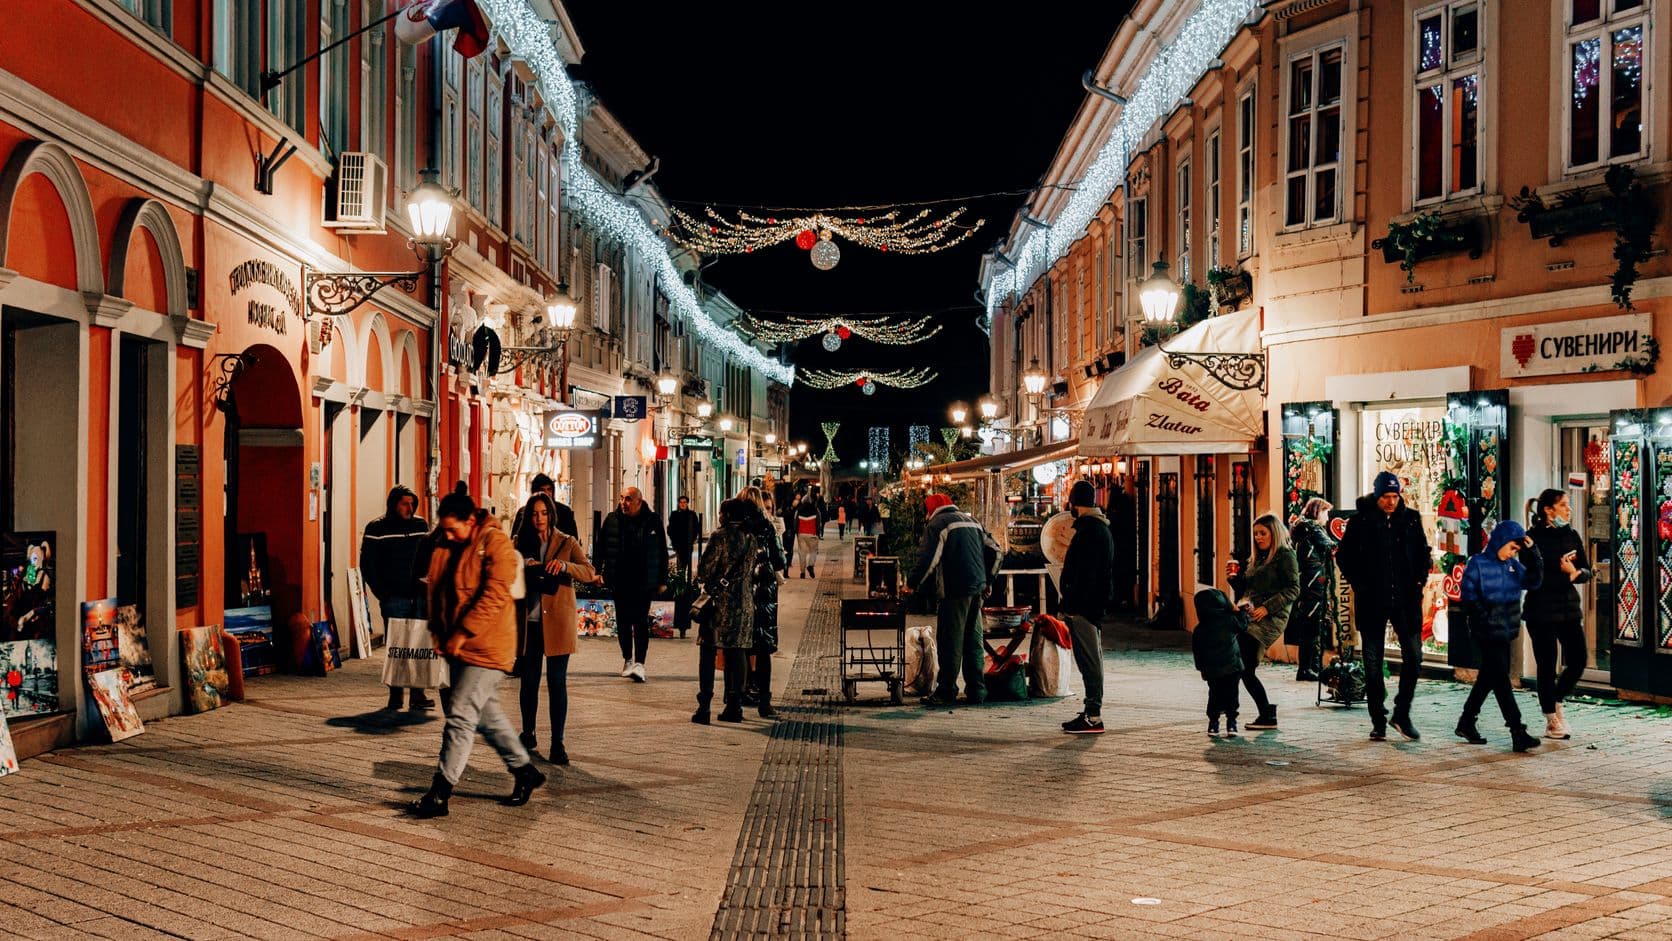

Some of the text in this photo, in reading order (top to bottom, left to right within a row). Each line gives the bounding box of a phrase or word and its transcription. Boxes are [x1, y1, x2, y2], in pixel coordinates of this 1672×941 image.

[1540, 330, 1638, 359] СУВЕНИРИ
[1158, 377, 1210, 412] Bata
[1144, 413, 1204, 435] Zlatar
